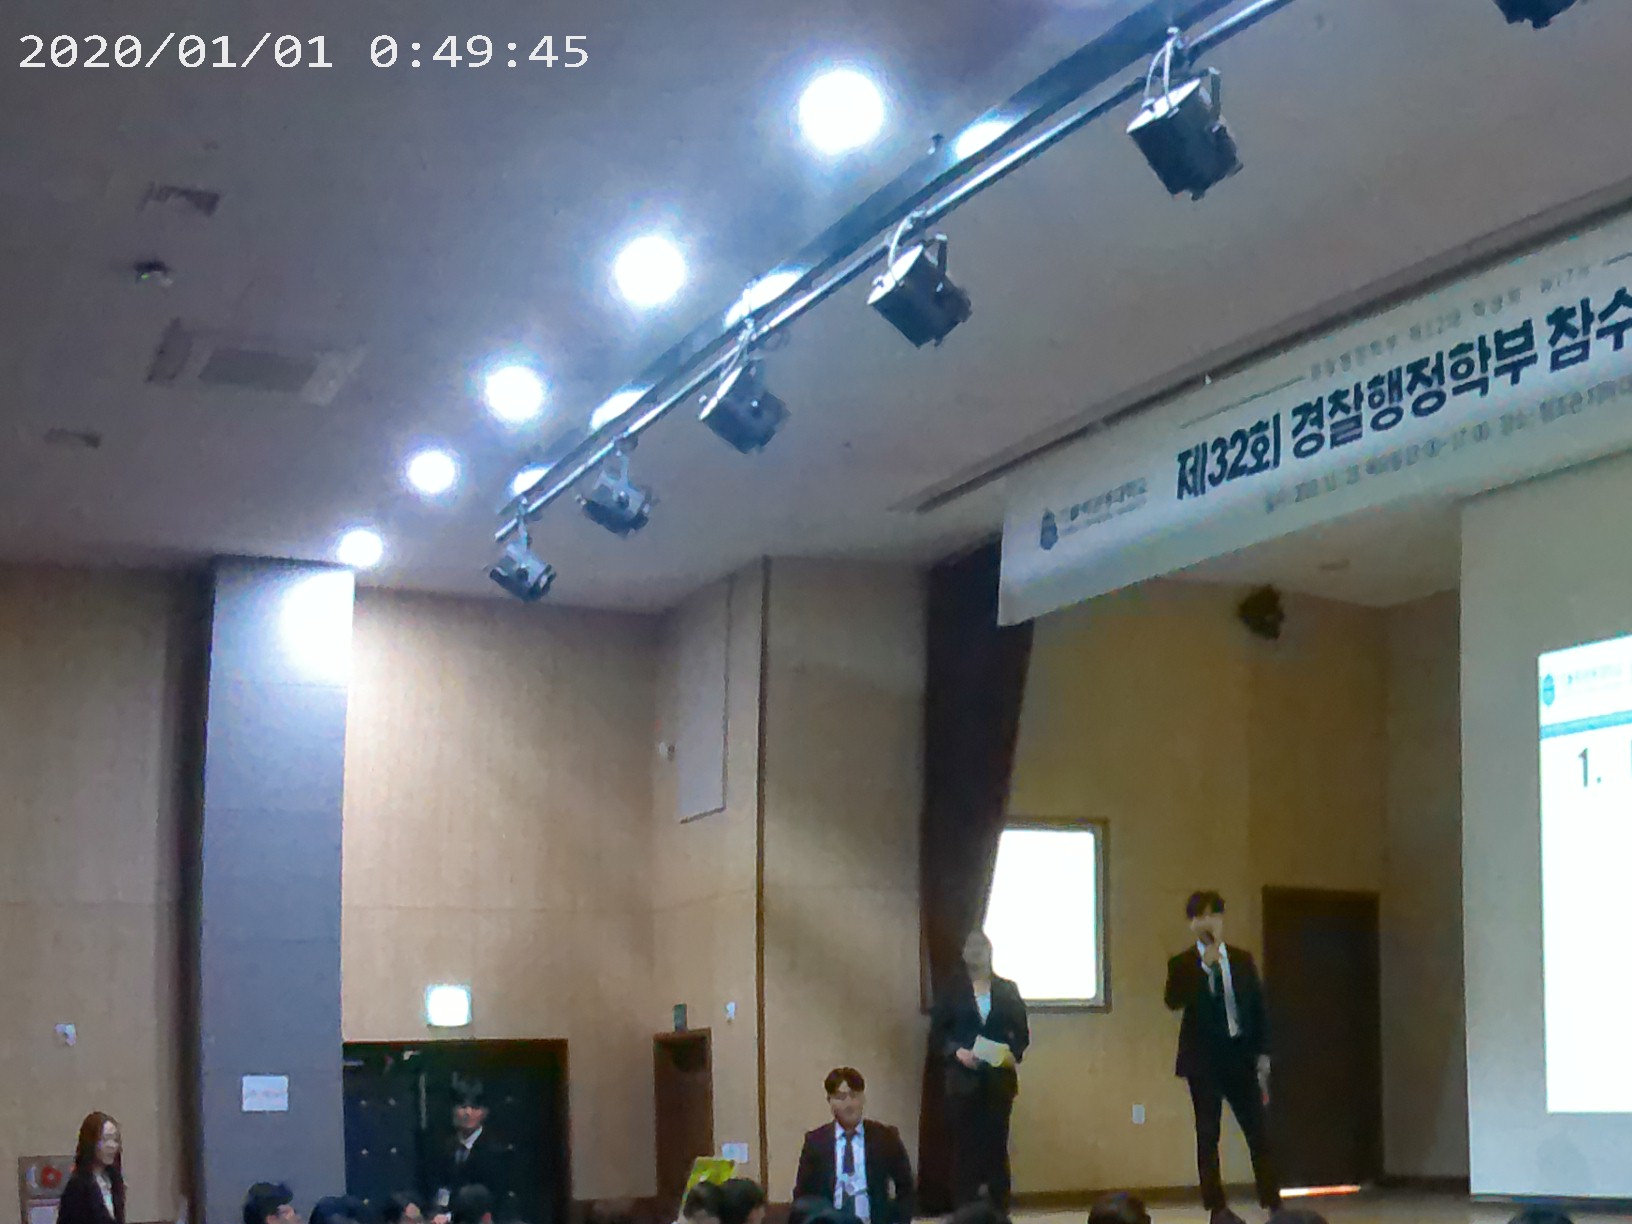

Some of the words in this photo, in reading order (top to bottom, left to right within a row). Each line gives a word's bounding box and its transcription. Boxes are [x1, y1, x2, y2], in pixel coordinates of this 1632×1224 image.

[1176, 411, 1281, 501] 제32회
[1291, 318, 1539, 460] 경찰행정학부
[1577, 747, 1602, 788] 1.
